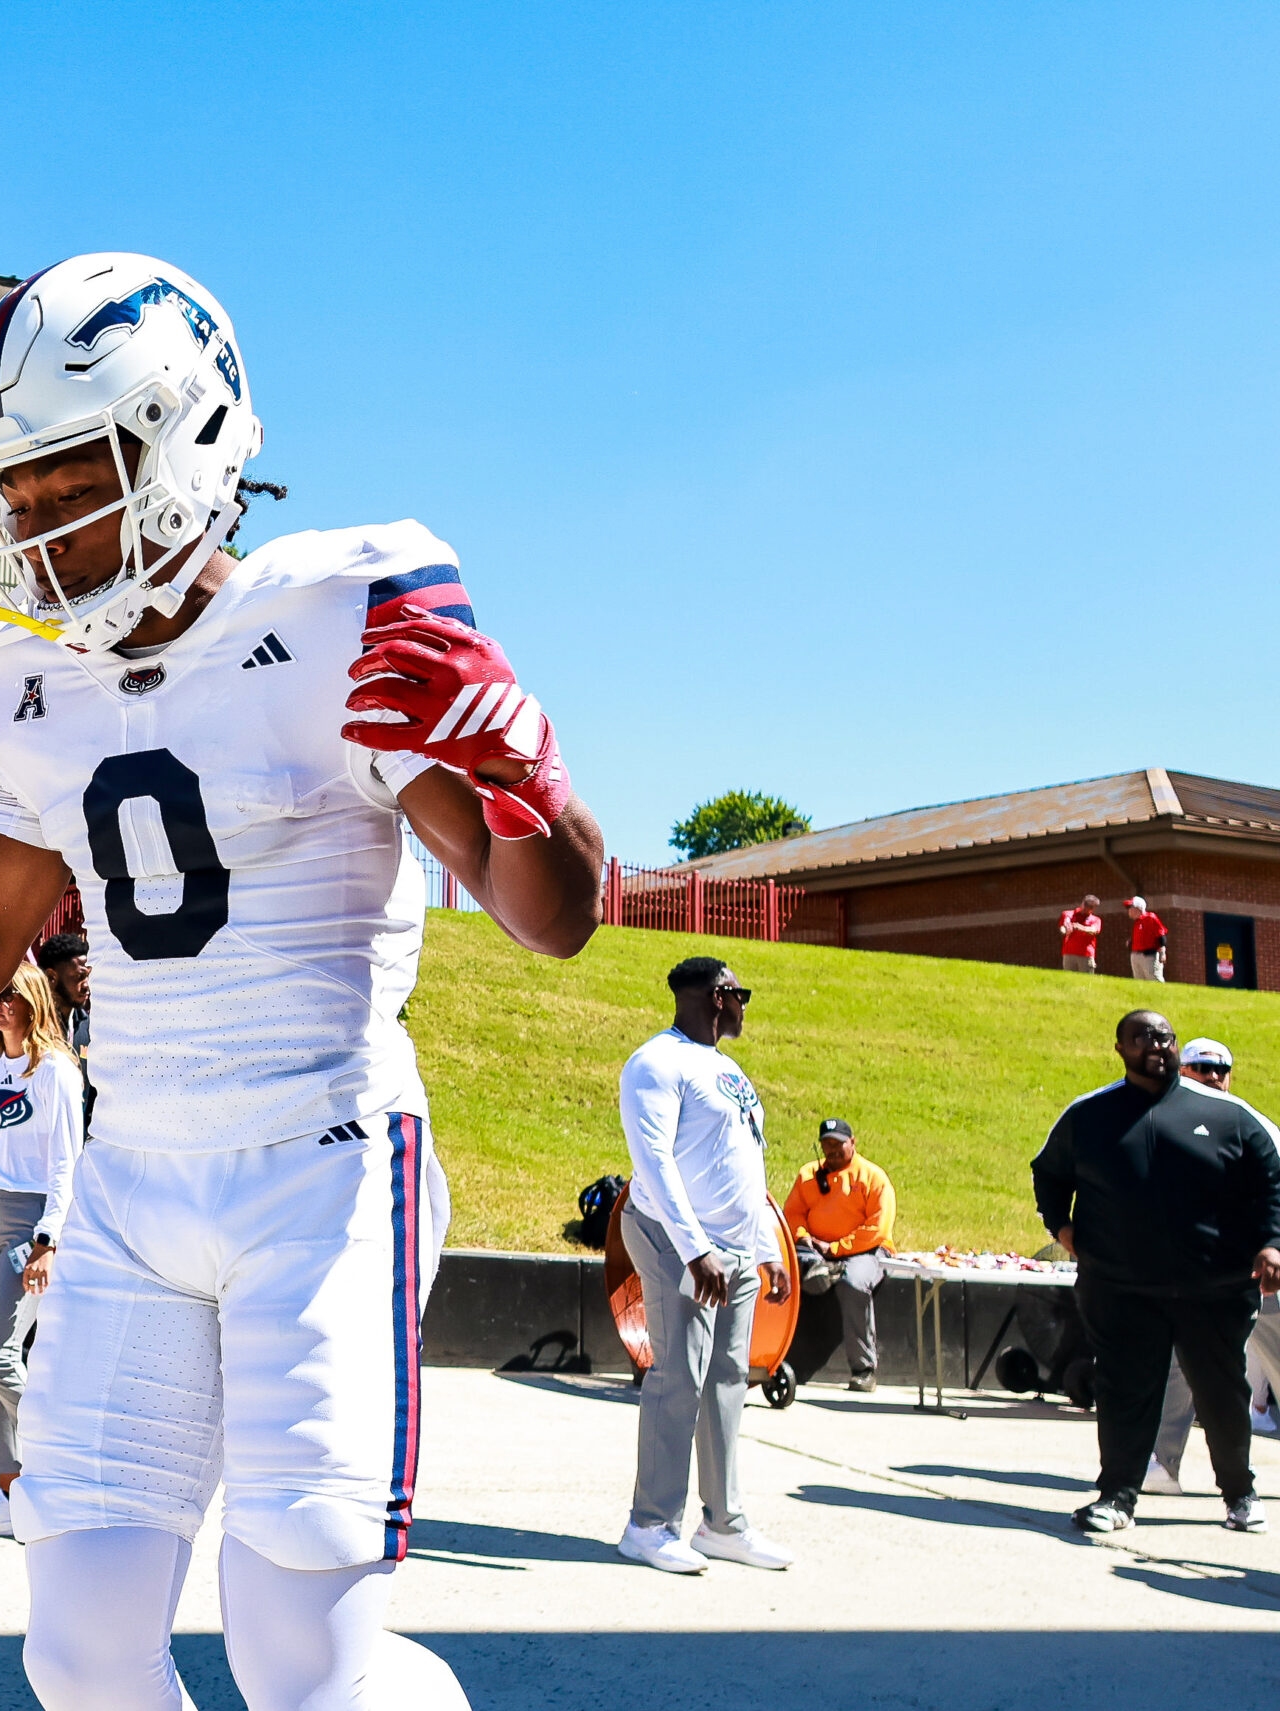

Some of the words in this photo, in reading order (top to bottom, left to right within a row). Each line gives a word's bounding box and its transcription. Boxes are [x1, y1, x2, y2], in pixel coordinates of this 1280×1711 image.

[166, 291, 238, 382] ATLATIC
[13, 674, 47, 722] A
[82, 747, 230, 961] 0
